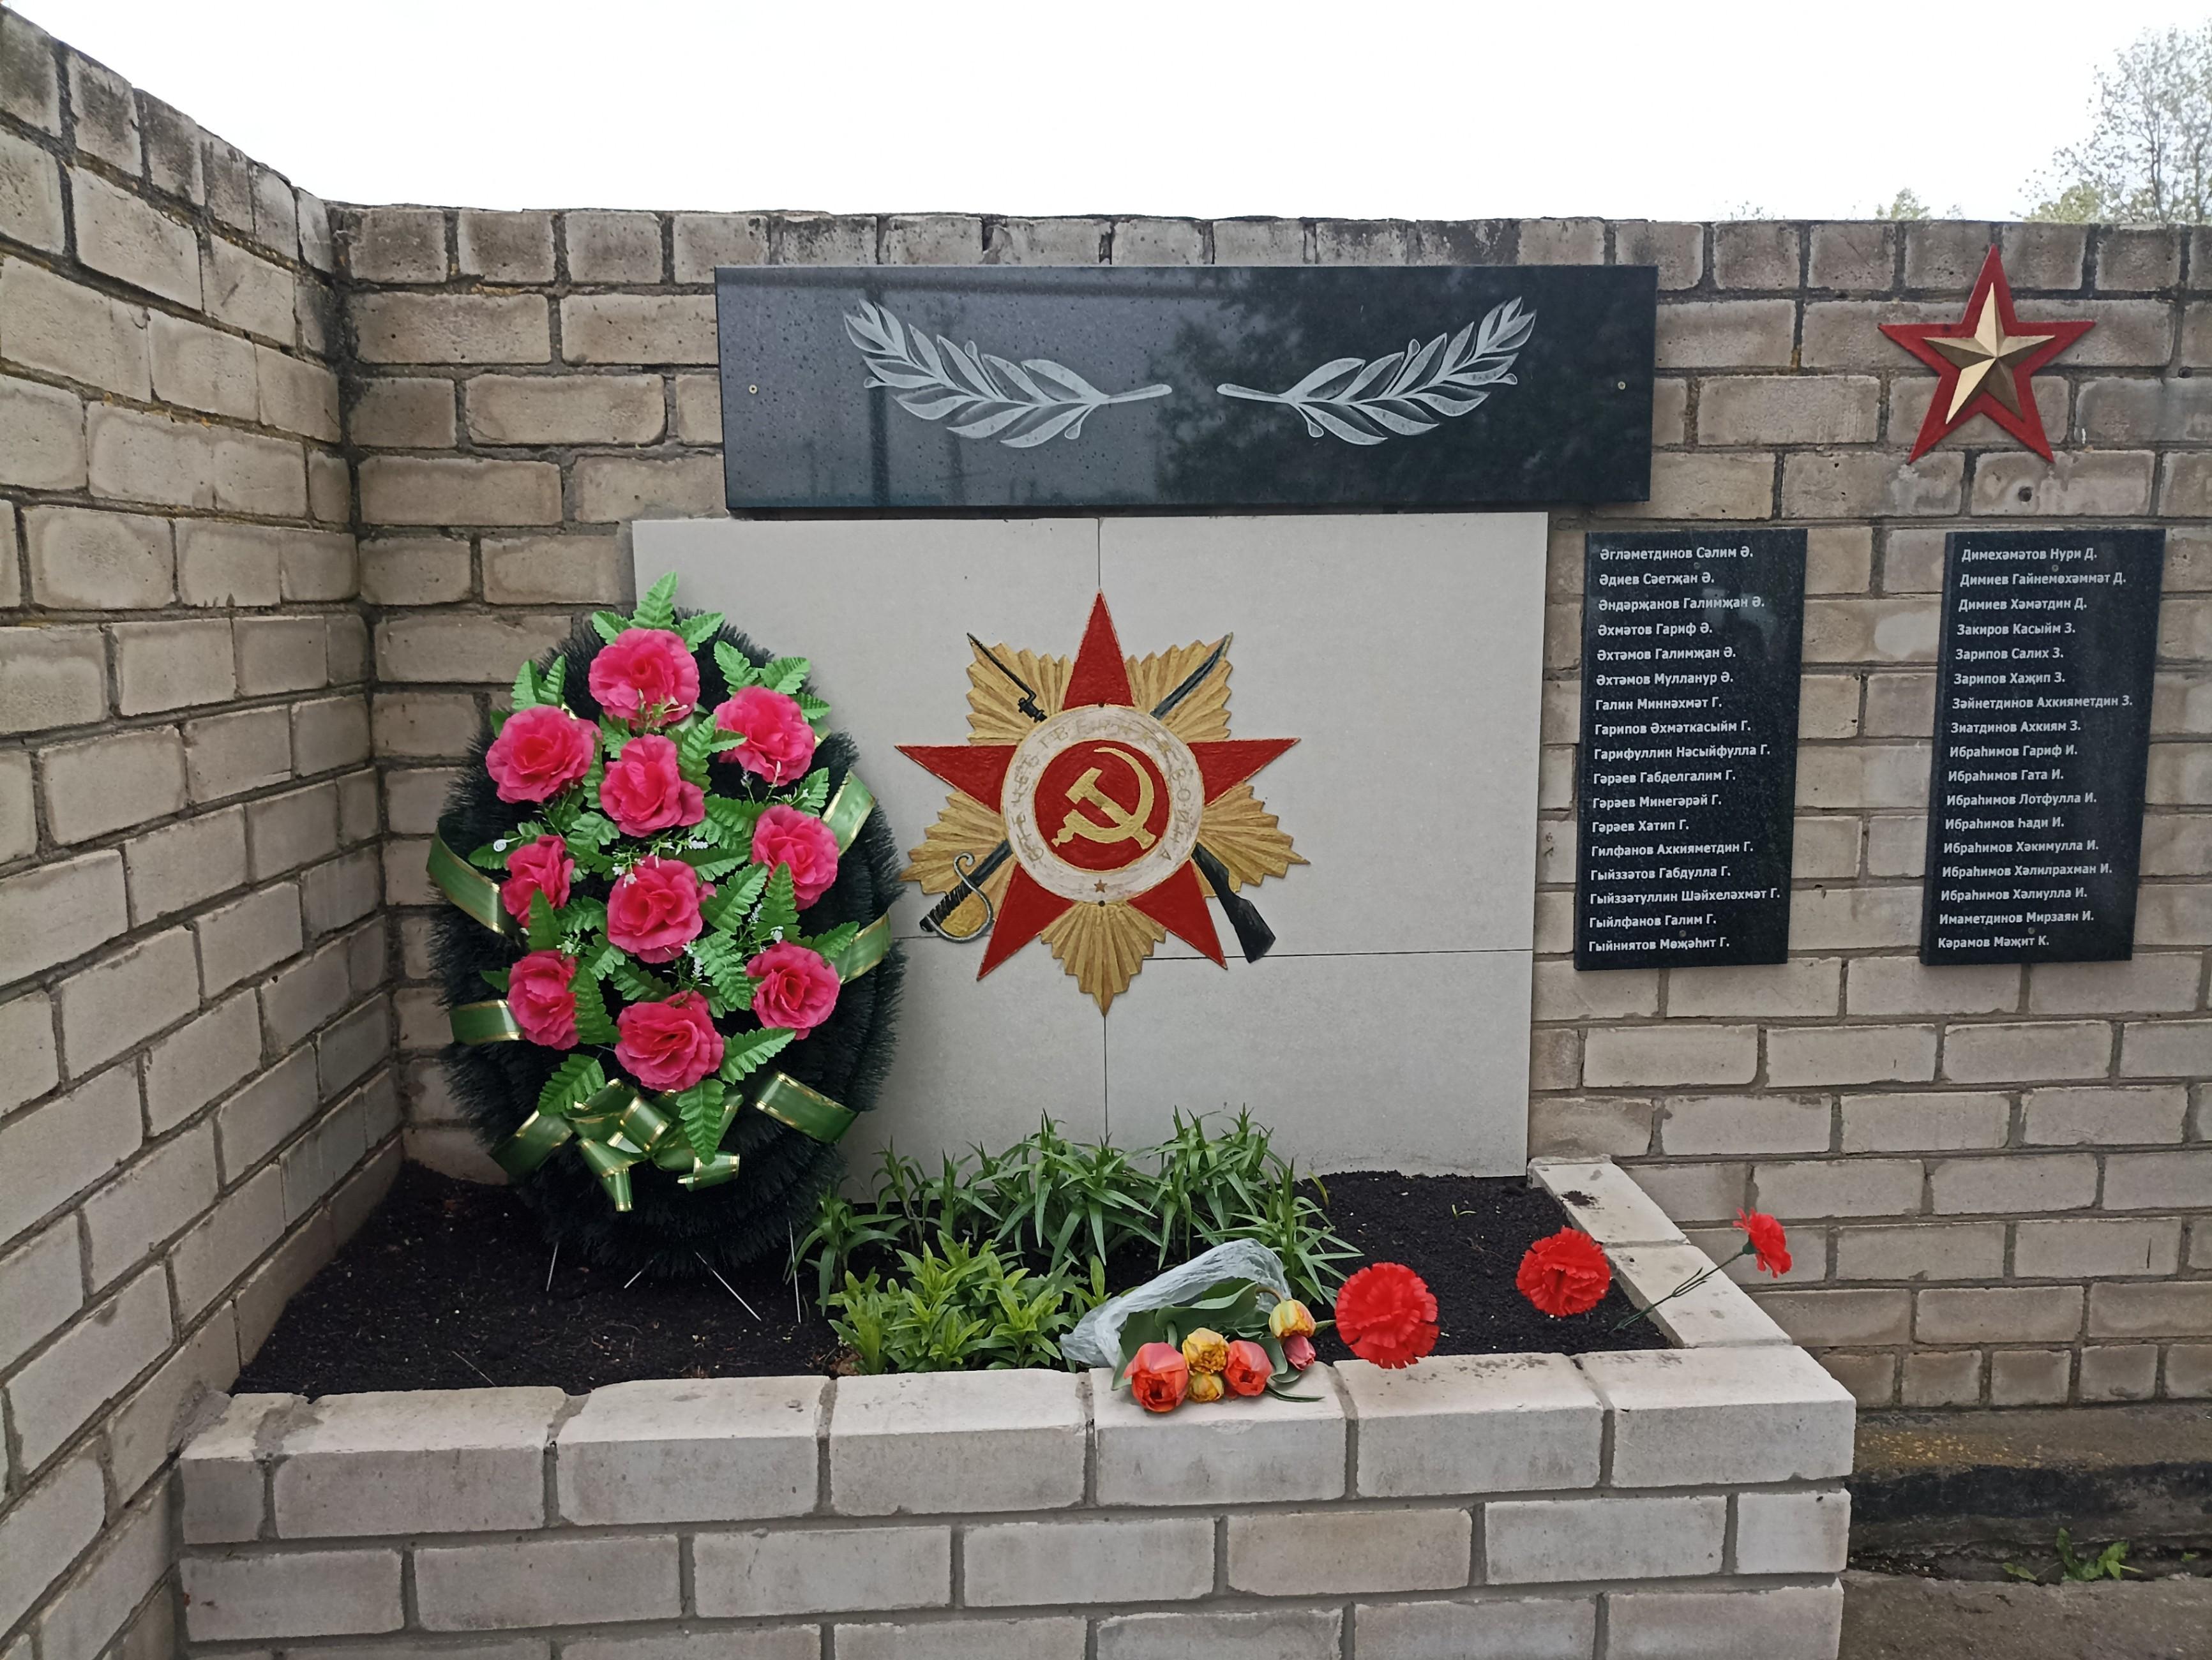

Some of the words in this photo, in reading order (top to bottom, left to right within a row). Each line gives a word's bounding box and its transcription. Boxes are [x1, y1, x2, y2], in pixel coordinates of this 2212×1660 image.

[1600, 548, 1693, 562] Әгләметдинов
[1696, 546, 1737, 558] Сәлим
[1740, 544, 1754, 558] Ә.
[1961, 548, 2047, 563] Димехәмәтов
[2050, 548, 2082, 562] Нури
[2084, 547, 2097, 562] Д.
[1599, 573, 1640, 588] Әдиев
[1643, 572, 1698, 586] Сәетҗан
[1701, 571, 1715, 583] Ә.
[1959, 573, 2009, 588] Димиев
[2112, 571, 2126, 586] Д.
[1598, 598, 1680, 613] Әндәрҗанов
[1683, 596, 1749, 610] Галимҗан
[1752, 595, 1765, 608] Ә.
[1958, 598, 2008, 613] Димиев
[2010, 598, 2072, 611] Хәмәтдин
[2073, 597, 2088, 611] Д.
[1597, 624, 1653, 637] Әхмәтов
[1655, 621, 1697, 638] Гариф
[1699, 621, 1713, 634] Ә.
[1957, 623, 2010, 638] Закиров
[2012, 621, 2061, 635] Касыйм
[2064, 622, 2076, 634] З.
[1597, 648, 1651, 662] Әхтәмов
[1655, 647, 1720, 661] Галимҗан
[1723, 645, 1736, 659] Ә.
[1955, 648, 2008, 663] Зарипов
[2011, 647, 2050, 660] Салих
[2052, 646, 2064, 659] З.
[1596, 674, 1651, 687] Әхтәмов
[1654, 672, 1718, 687] Мулланур
[1720, 670, 1734, 683] Ә.
[1953, 672, 2006, 687] Зарипов
[2009, 672, 2051, 685] Хаҗип
[2054, 671, 2066, 684] З.
[1595, 699, 1634, 712] Галин
[1637, 697, 1709, 710] Миннәхмәт
[1712, 696, 1722, 708] Г.
[1952, 696, 2034, 710] Зәйнетдинов
[2036, 696, 2119, 709] Ахкияметдин
[2121, 694, 2133, 707] З.
[1595, 723, 1648, 738] Гарипов
[1650, 719, 1737, 735] Әхмәткасыйм
[1740, 719, 1751, 732] Г.
[1950, 722, 2017, 735] Зиатдинов
[2020, 720, 2067, 733] Ахкиям
[2070, 719, 2081, 731] З.
[1594, 747, 1673, 763] Гарифуллин
[1676, 744, 1757, 759] Нәсыйфулла
[1760, 743, 1771, 756] Г.
[1950, 745, 2020, 761] Ибраһимов
[2022, 744, 2063, 759] Гариф
[2065, 744, 2078, 756] И.
[1593, 773, 1637, 787] Гәрәев
[1640, 770, 1722, 784] Габделгалим
[1725, 768, 1736, 781] Г.
[1948, 769, 2018, 785] Ибраһимов
[2020, 769, 2048, 781] Гата
[2051, 768, 2064, 781] И.
[1592, 796, 1636, 812] Гәрәев
[1639, 793, 1708, 809] Минегәрәй
[1711, 793, 1722, 806] Г.
[1946, 793, 2017, 809] Ибраһимов
[2018, 791, 2081, 807] Лотфулла
[2084, 791, 2097, 804] И.
[1591, 821, 1636, 835] Гәрәев
[1637, 819, 1676, 832] Хатип
[1679, 818, 1689, 831] Г.
[1945, 817, 2015, 833] Ибраһимов
[2017, 817, 2049, 830] Һади
[2052, 816, 2065, 828] И.
[1591, 844, 1654, 859] Гилфанов
[1656, 843, 1740, 855] Ахкияметдин
[1743, 841, 1754, 853] Г.
[1943, 841, 2013, 856] Ибраһимов
[2015, 841, 2083, 855] Хәкимулла
[2086, 839, 2099, 851] И.
[1590, 868, 1656, 881] Гыйззәтов
[1659, 866, 1717, 880] Габдулла
[1720, 865, 1731, 877] Г.
[1942, 865, 2012, 880] Ибраһимов
[2013, 864, 2096, 878] Хәлилрахман
[2100, 862, 2112, 874] И.
[1590, 892, 1678, 906] Гыйззәтуллин
[1681, 888, 1768, 902] Шәйхеләхмәт
[1770, 887, 1780, 899] Г.
[1941, 889, 2010, 904] Ибраһимов
[2012, 888, 2072, 901] Хәлиулла
[2075, 886, 2088, 898] И.
[1589, 915, 1662, 931] Гыйлфанов
[1664, 914, 1703, 927] Галим
[1706, 913, 1717, 925] Г.
[1939, 913, 2023, 926] Имаметдинов
[2026, 911, 2079, 925] Мирзаян
[2082, 909, 2095, 922] И.
[1588, 939, 1657, 953] Гыйниятов
[1719, 936, 1730, 948] Г.
[1937, 936, 1990, 951] Кәрамов
[1993, 936, 2035, 949] Мәҗит
[2038, 934, 2049, 946] К.
